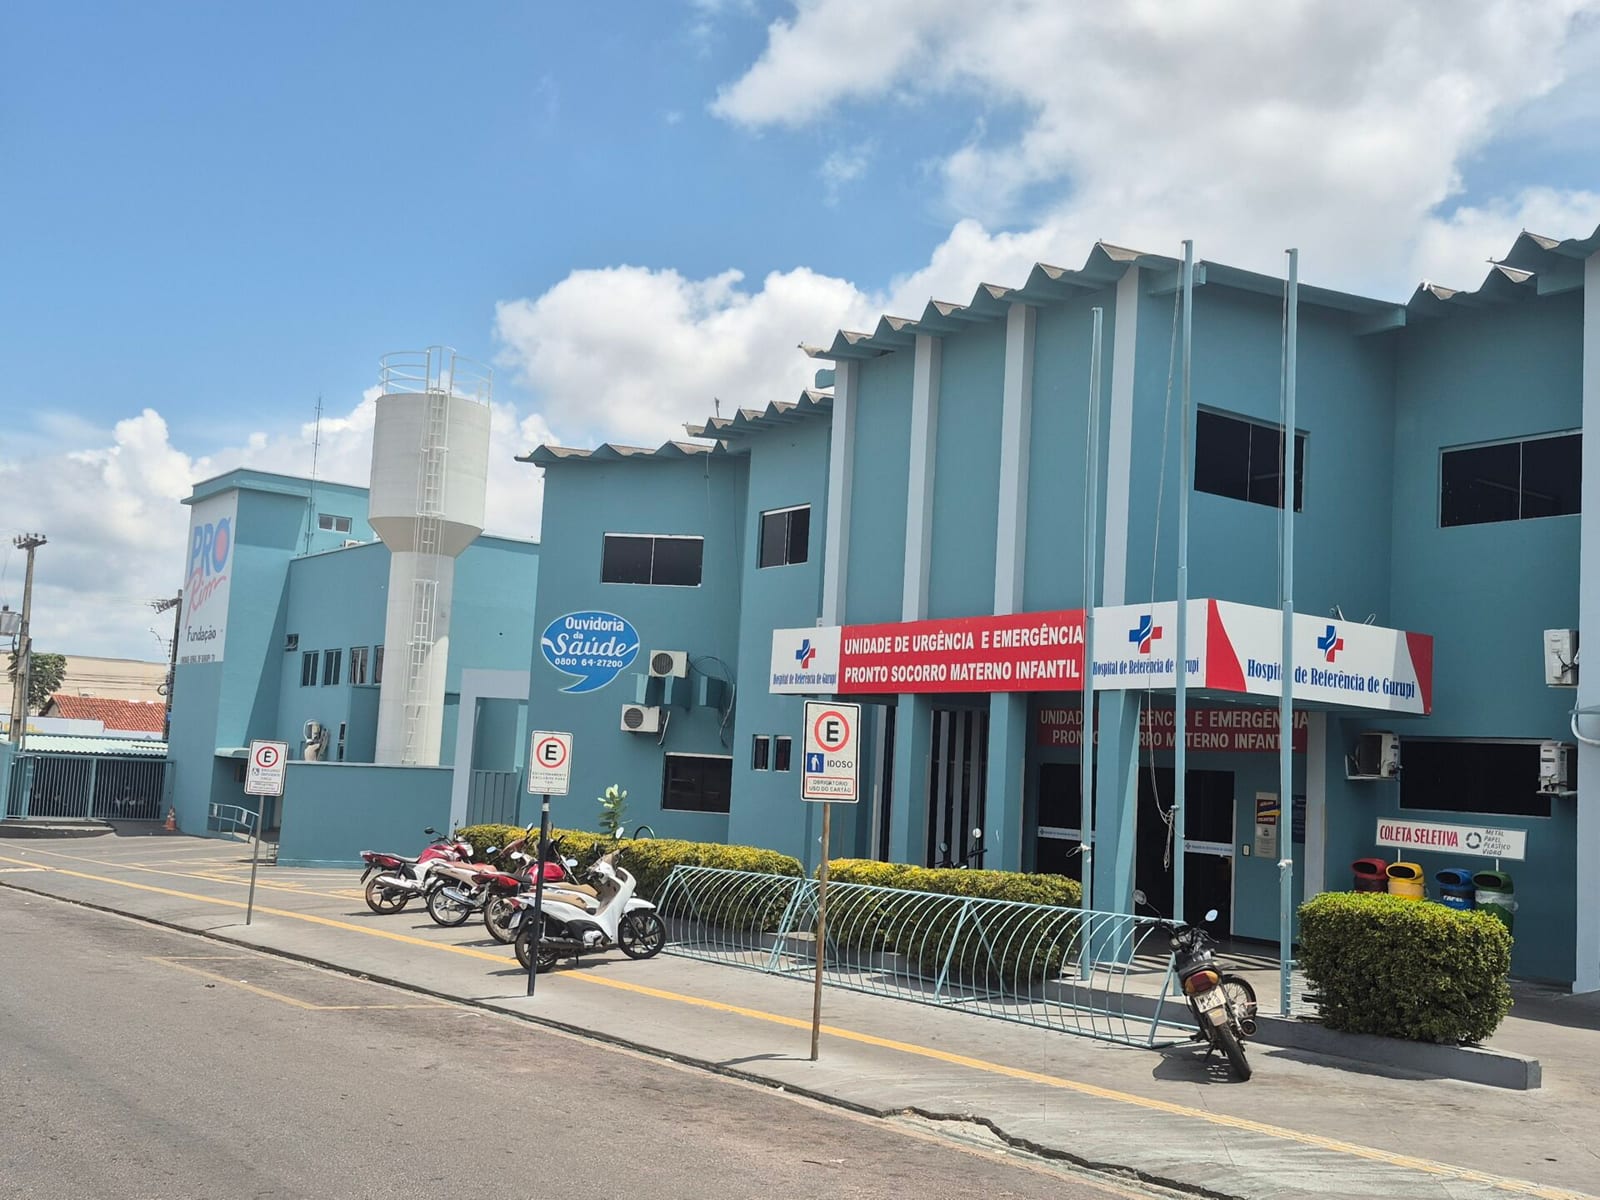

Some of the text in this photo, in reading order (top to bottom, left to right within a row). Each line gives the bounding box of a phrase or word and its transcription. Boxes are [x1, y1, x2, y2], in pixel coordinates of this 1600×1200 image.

[185, 566, 227, 629] Rim
[565, 616, 624, 631] Ouvidoria
[187, 625, 216, 643] Fundação
[573, 631, 584, 639] da
[844, 623, 1084, 654] UNIDADE DE URGÊNCIA E EMERGÊNCIA
[550, 633, 630, 657] Saúde
[555, 657, 623, 668] 0800 64-27200
[844, 659, 1079, 683] PRONTO SOCORRO MATERNO INFANTIL
[1093, 660, 1118, 677] Hospital
[1120, 660, 1128, 674] de
[1165, 658, 1174, 673] de
[1247, 659, 1415, 700] Hospit de Referência de Gurupi
[1040, 709, 1083, 725] UNIDAD
[1195, 711, 1203, 726] E
[826, 721, 839, 742] E
[1166, 732, 1229, 748] MTERNO
[264, 751, 272, 763] E
[545, 744, 557, 760] E
[827, 760, 853, 768] IDOSO
[1380, 825, 1459, 847] COLETA SELETIVA
[1485, 829, 1504, 837] METAL
